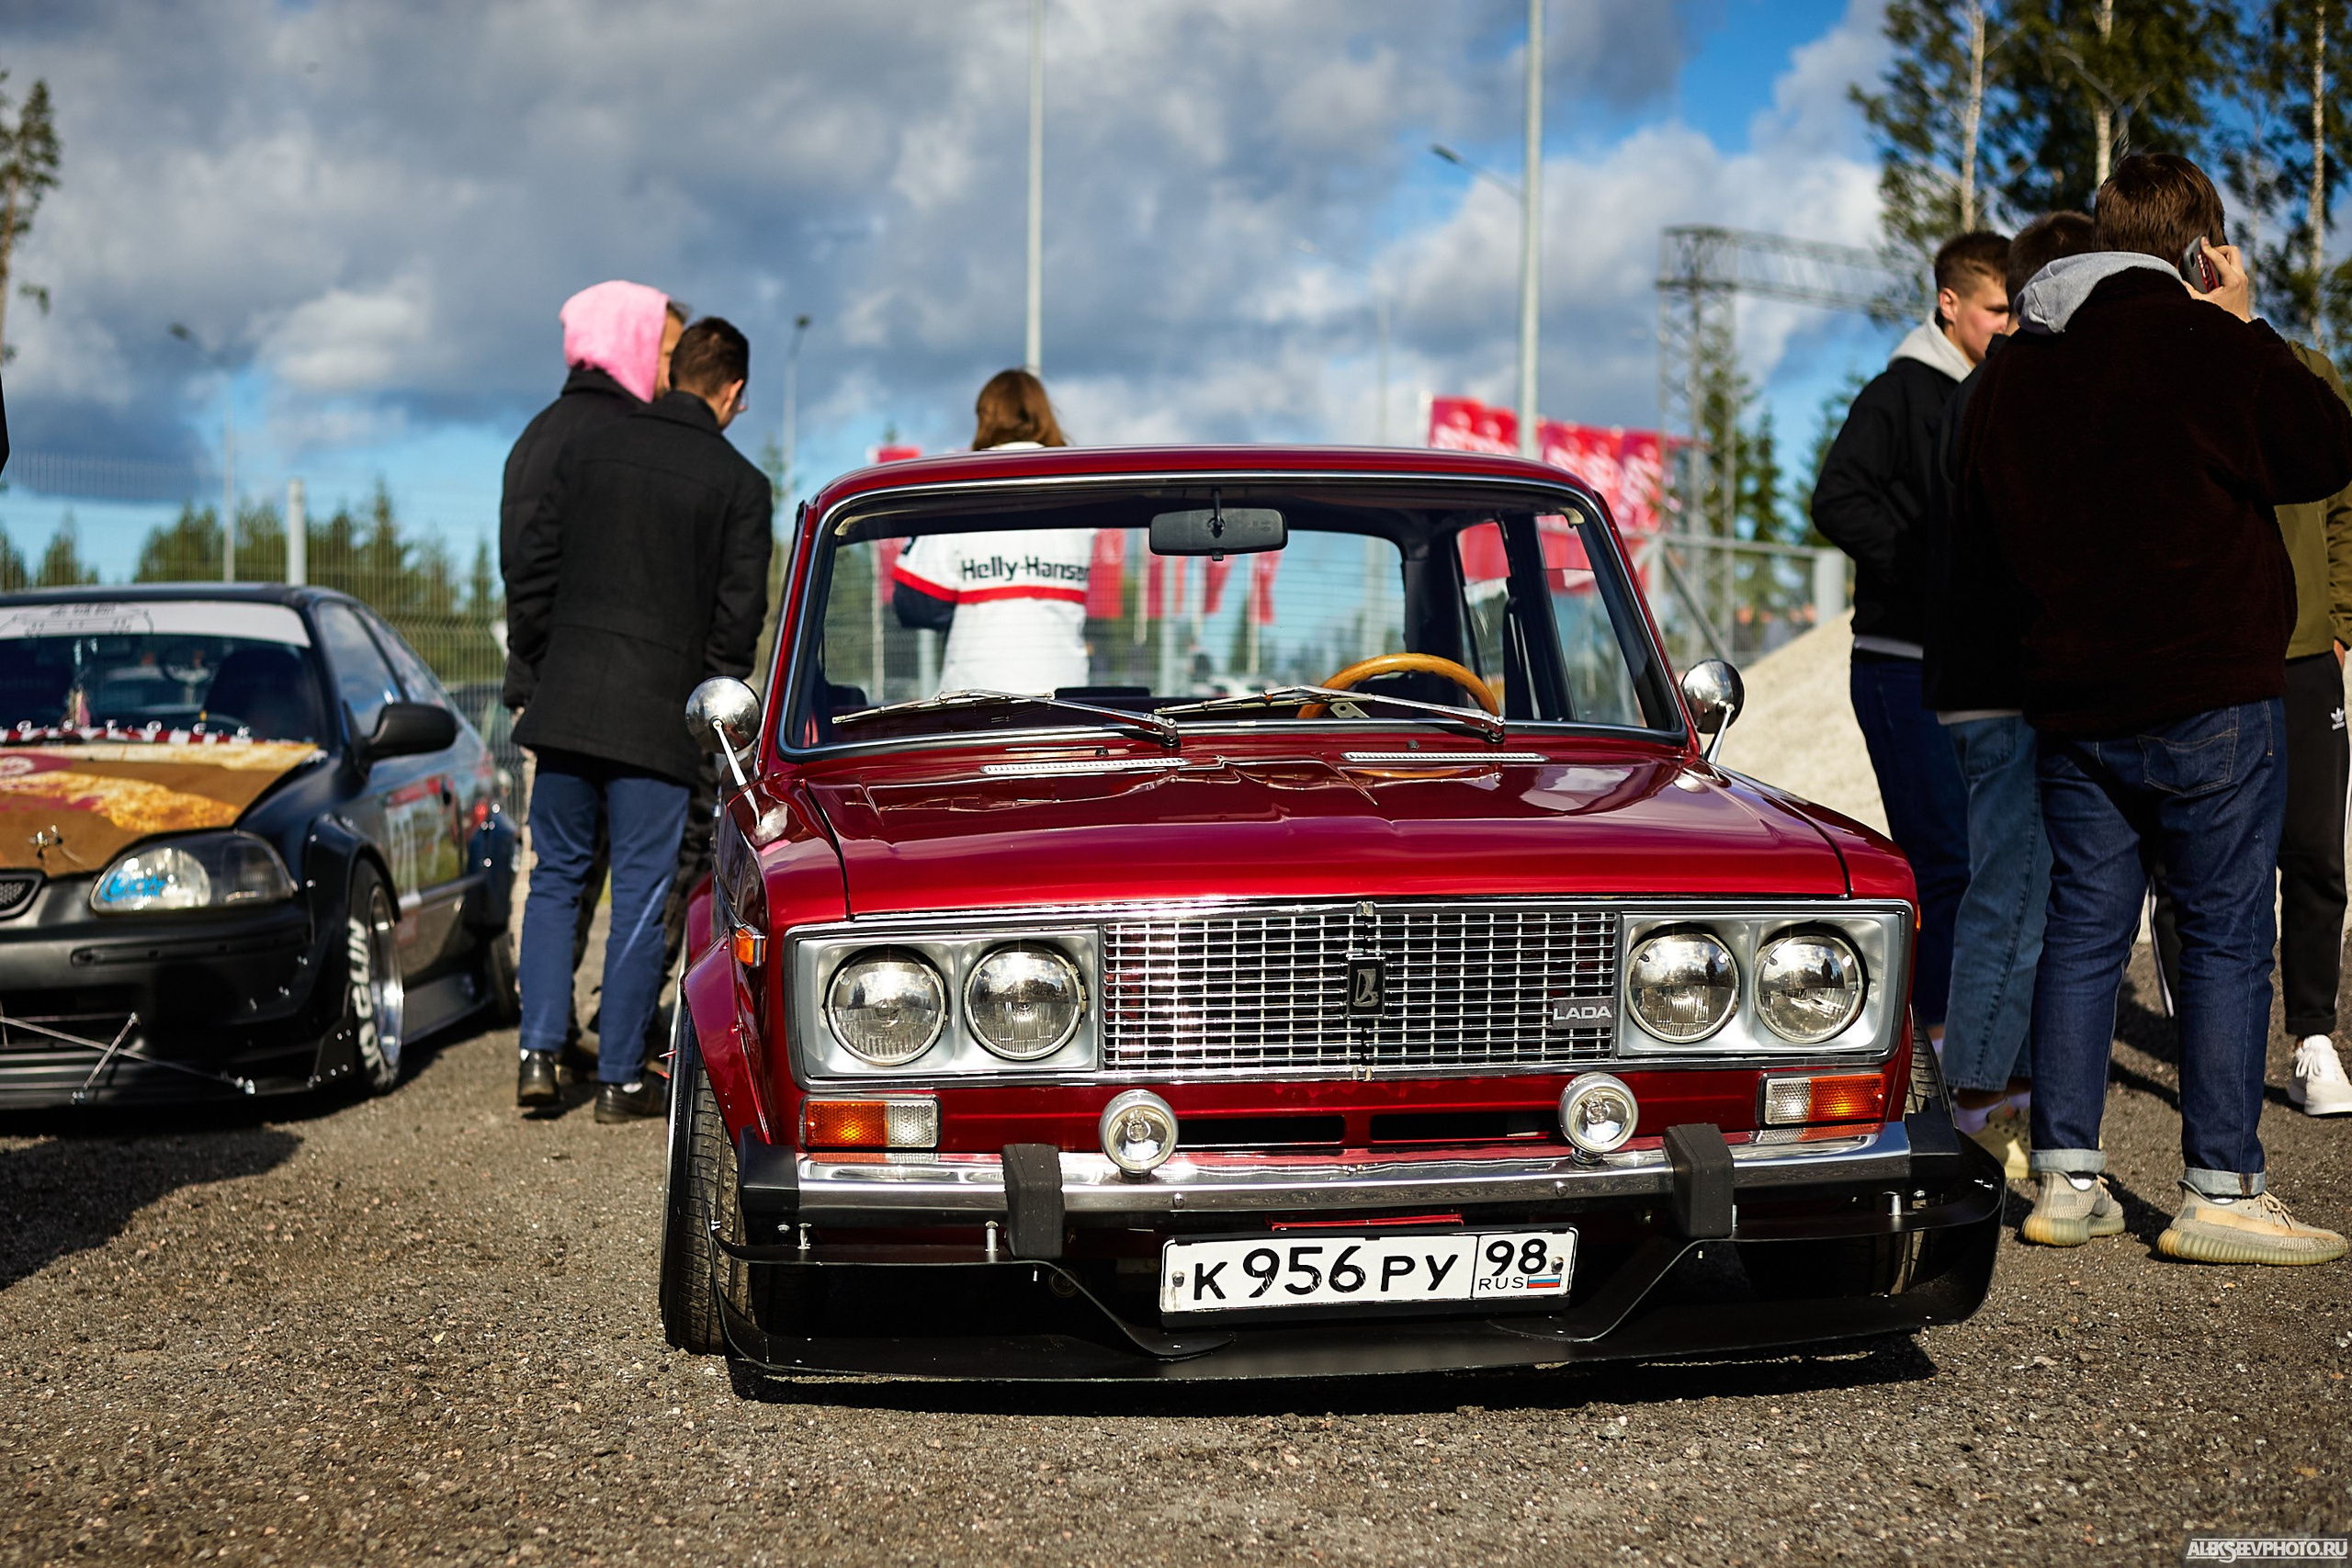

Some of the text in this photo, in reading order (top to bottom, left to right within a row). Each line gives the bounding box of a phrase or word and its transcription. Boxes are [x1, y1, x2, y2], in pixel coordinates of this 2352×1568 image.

[1553, 1006, 1611, 1021] LADA
[1485, 1238, 1548, 1277] 98
[1478, 1277, 1524, 1291] RUS
